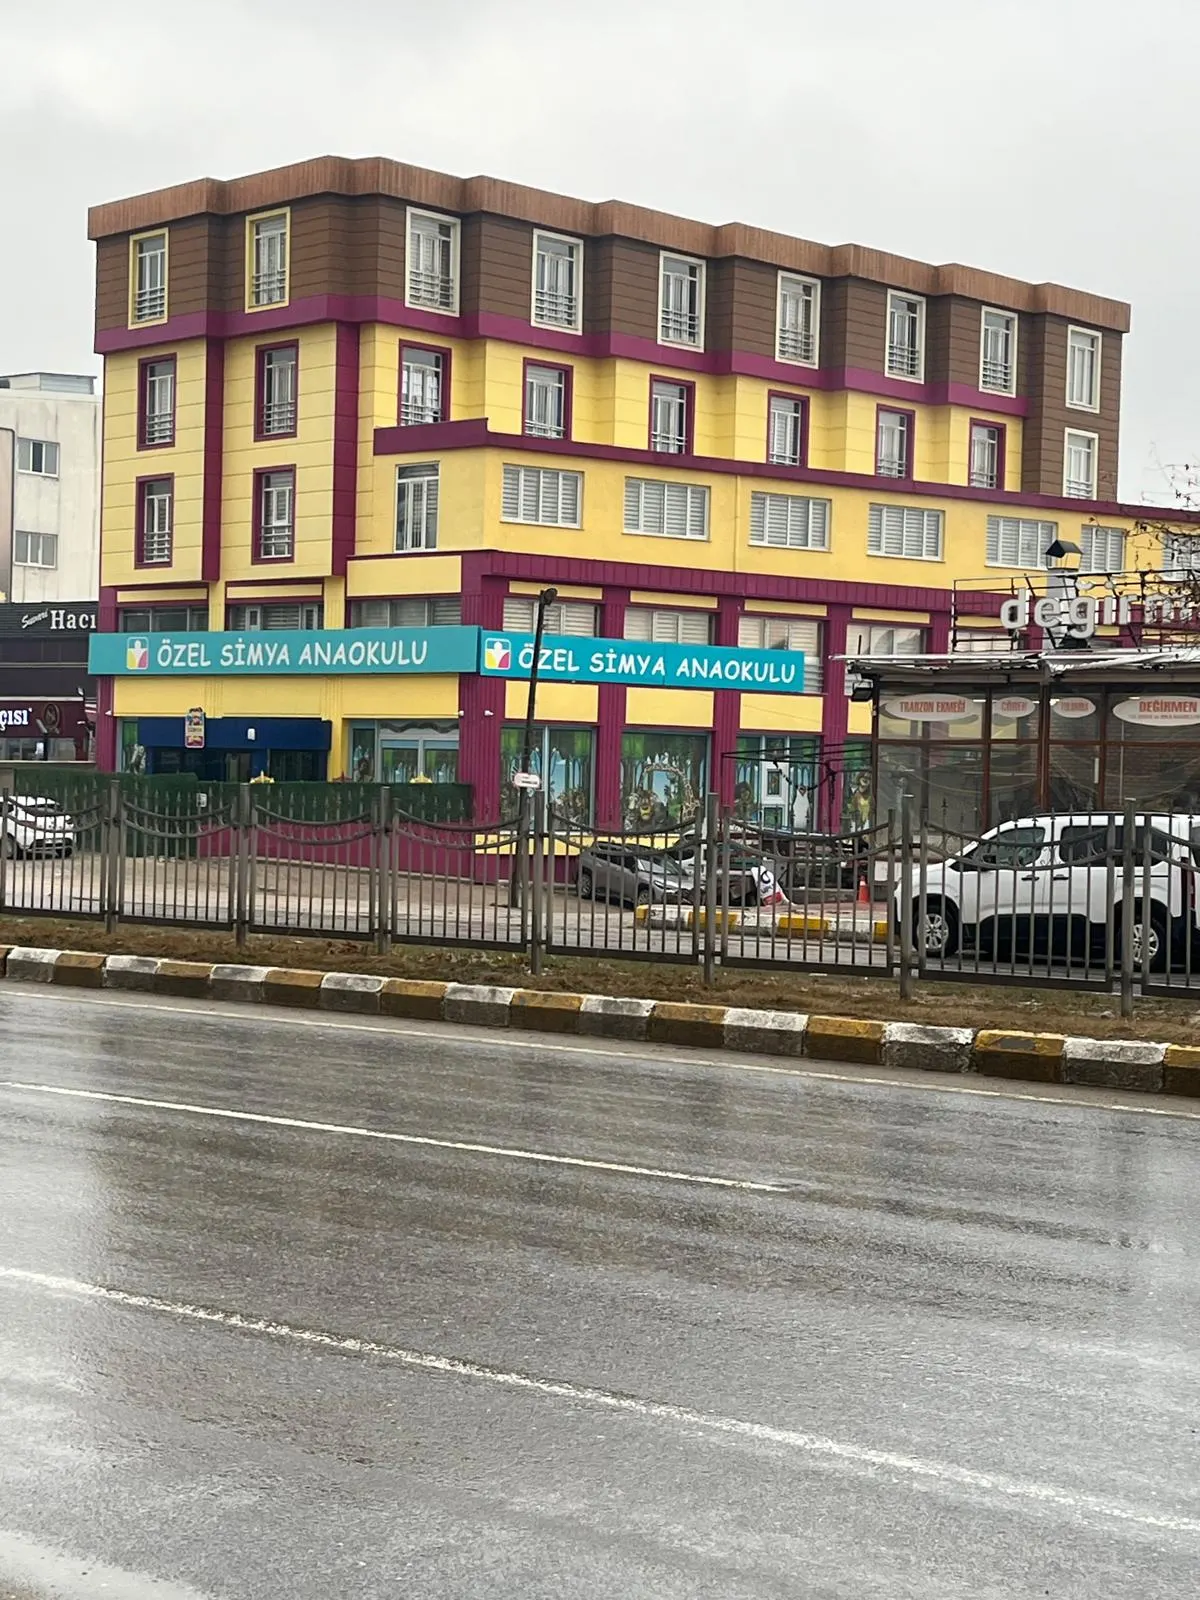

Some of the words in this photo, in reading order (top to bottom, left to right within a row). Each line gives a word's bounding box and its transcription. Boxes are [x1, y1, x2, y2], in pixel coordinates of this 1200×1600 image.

[50, 609, 97, 630] Hacı
[157, 638, 211, 668] ÖZEL
[219, 637, 290, 667] SİMYA
[298, 640, 428, 666] ANAOKULU
[518, 643, 580, 673] ÖZEL
[589, 648, 666, 677] SİMYA
[676, 658, 796, 684] ANAOKULU
[1139, 700, 1198, 713] DEĞİRMEN
